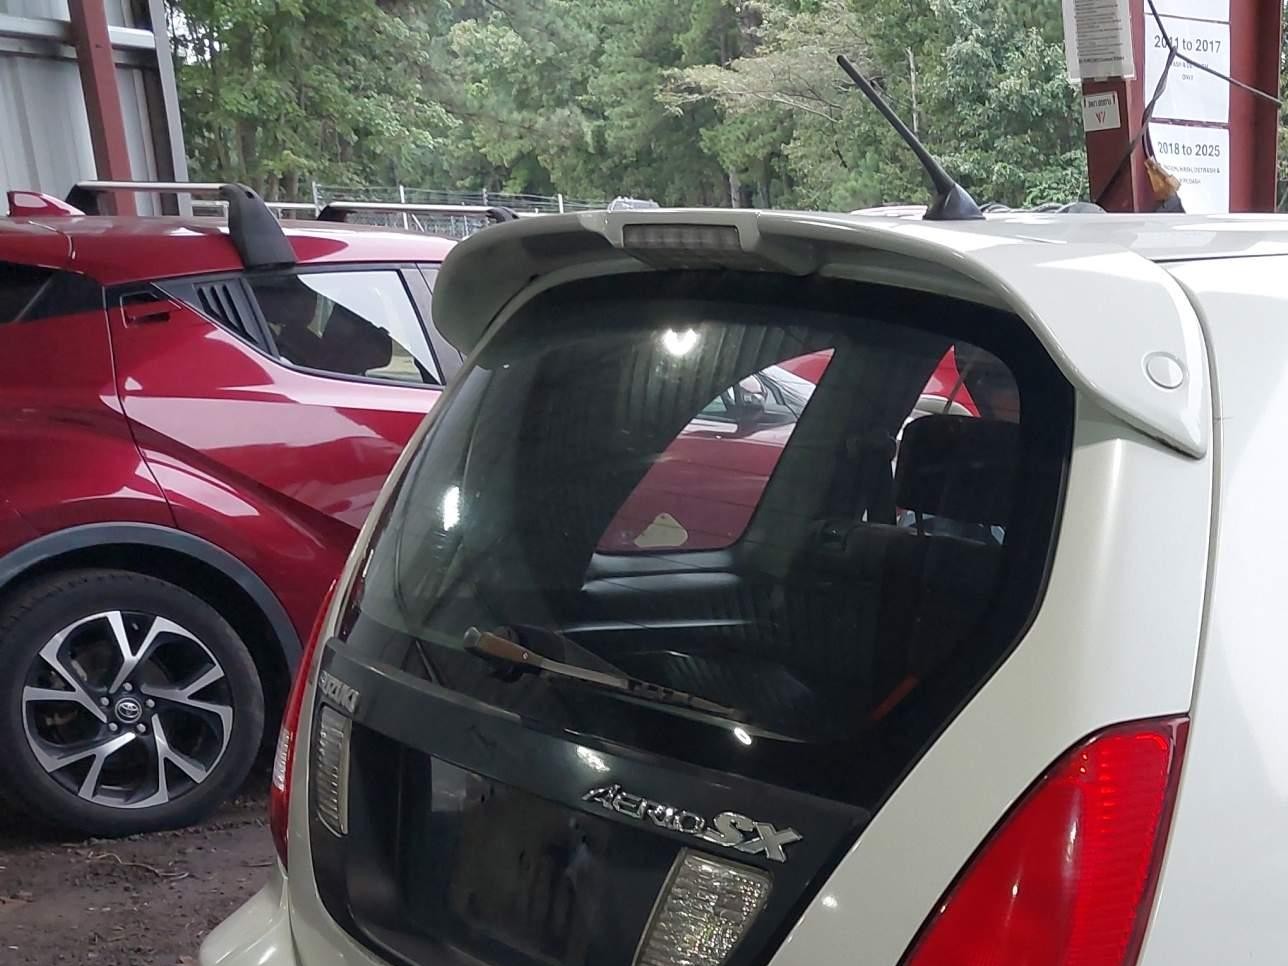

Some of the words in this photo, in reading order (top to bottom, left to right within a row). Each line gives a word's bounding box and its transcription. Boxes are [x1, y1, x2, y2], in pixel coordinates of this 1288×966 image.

[1182, 38, 1193, 51] to
[1195, 38, 1221, 53] 2017
[1157, 141, 1180, 155] 2018
[1182, 143, 1193, 156] to
[1195, 144, 1221, 157] 2025
[318, 670, 361, 713] SUZUKI
[696, 811, 804, 863] SX
